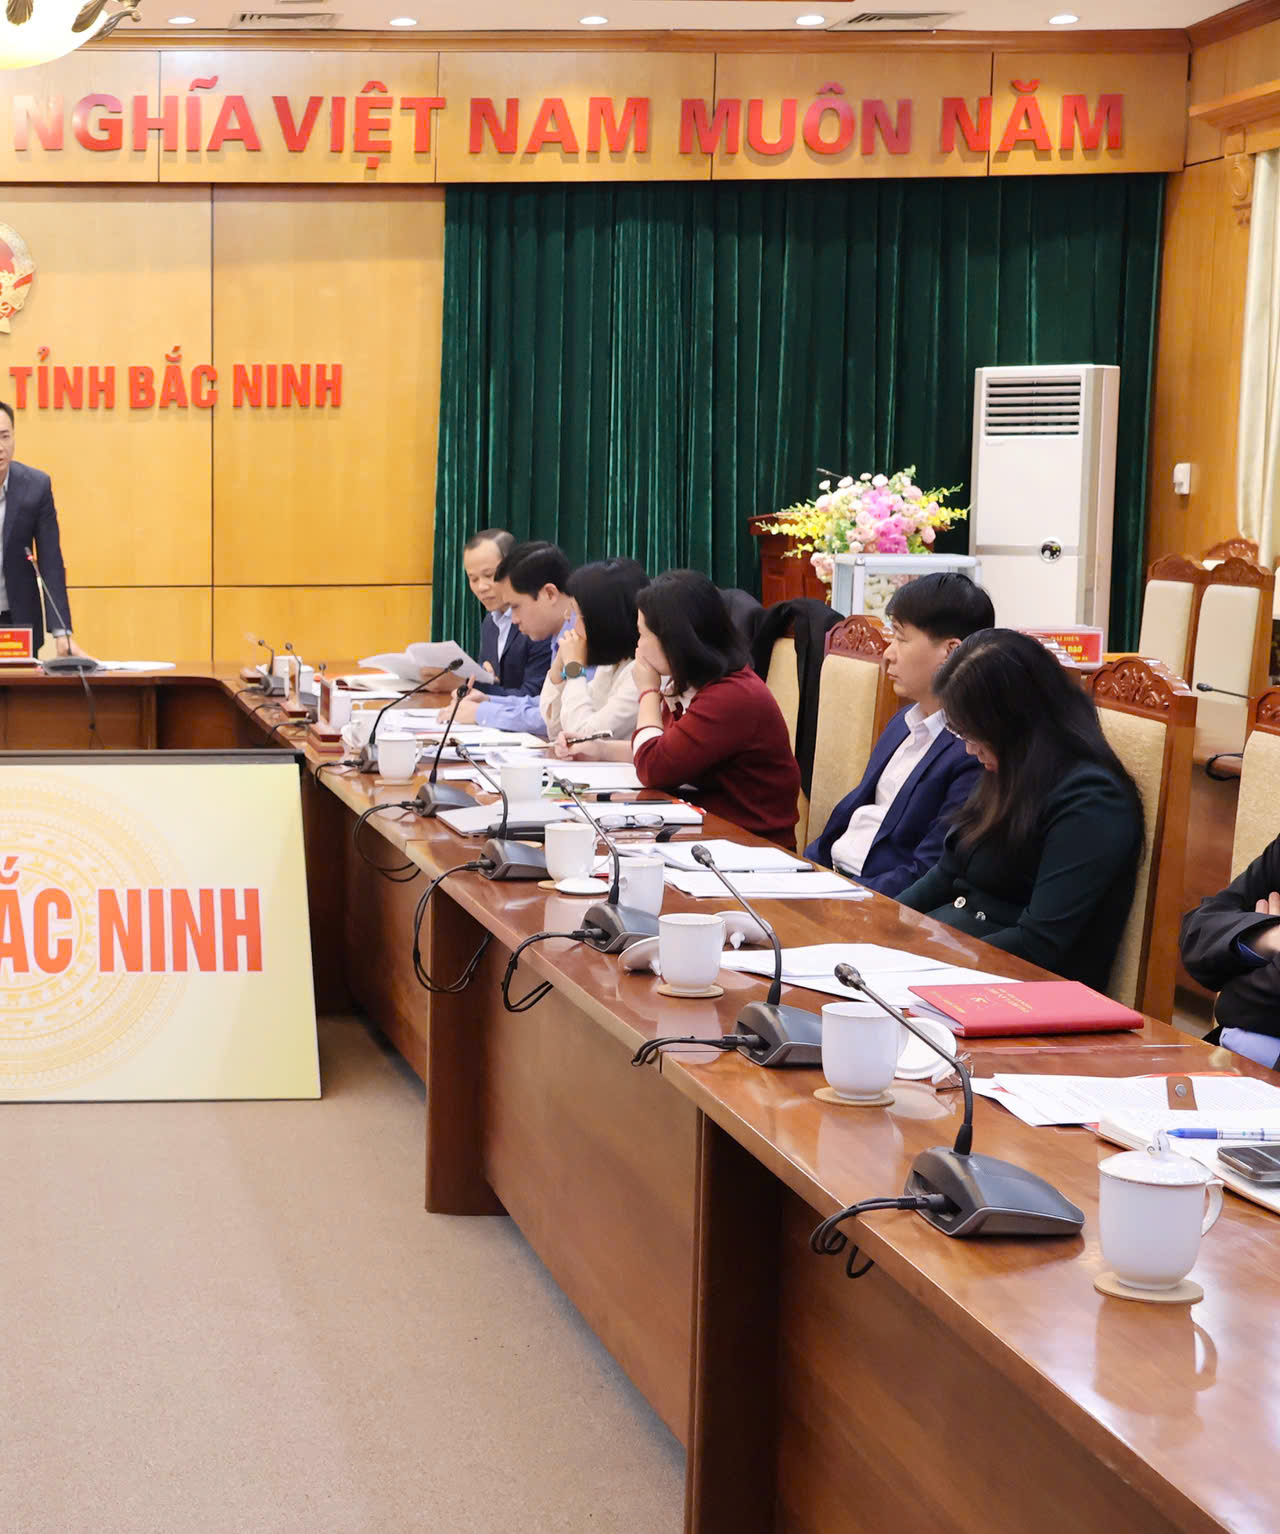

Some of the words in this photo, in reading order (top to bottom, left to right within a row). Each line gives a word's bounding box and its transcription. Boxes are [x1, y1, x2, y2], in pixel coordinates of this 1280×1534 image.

[13, 75, 261, 152] NGHĨA
[272, 80, 446, 169] VIỆT
[469, 96, 650, 154] NAM
[679, 82, 912, 156] MUÔN
[941, 79, 1124, 153] NĂM
[9, 345, 116, 410] TỈNH
[129, 344, 218, 409] BẮC
[233, 363, 343, 409] NINH
[97, 888, 263, 972] NINH
